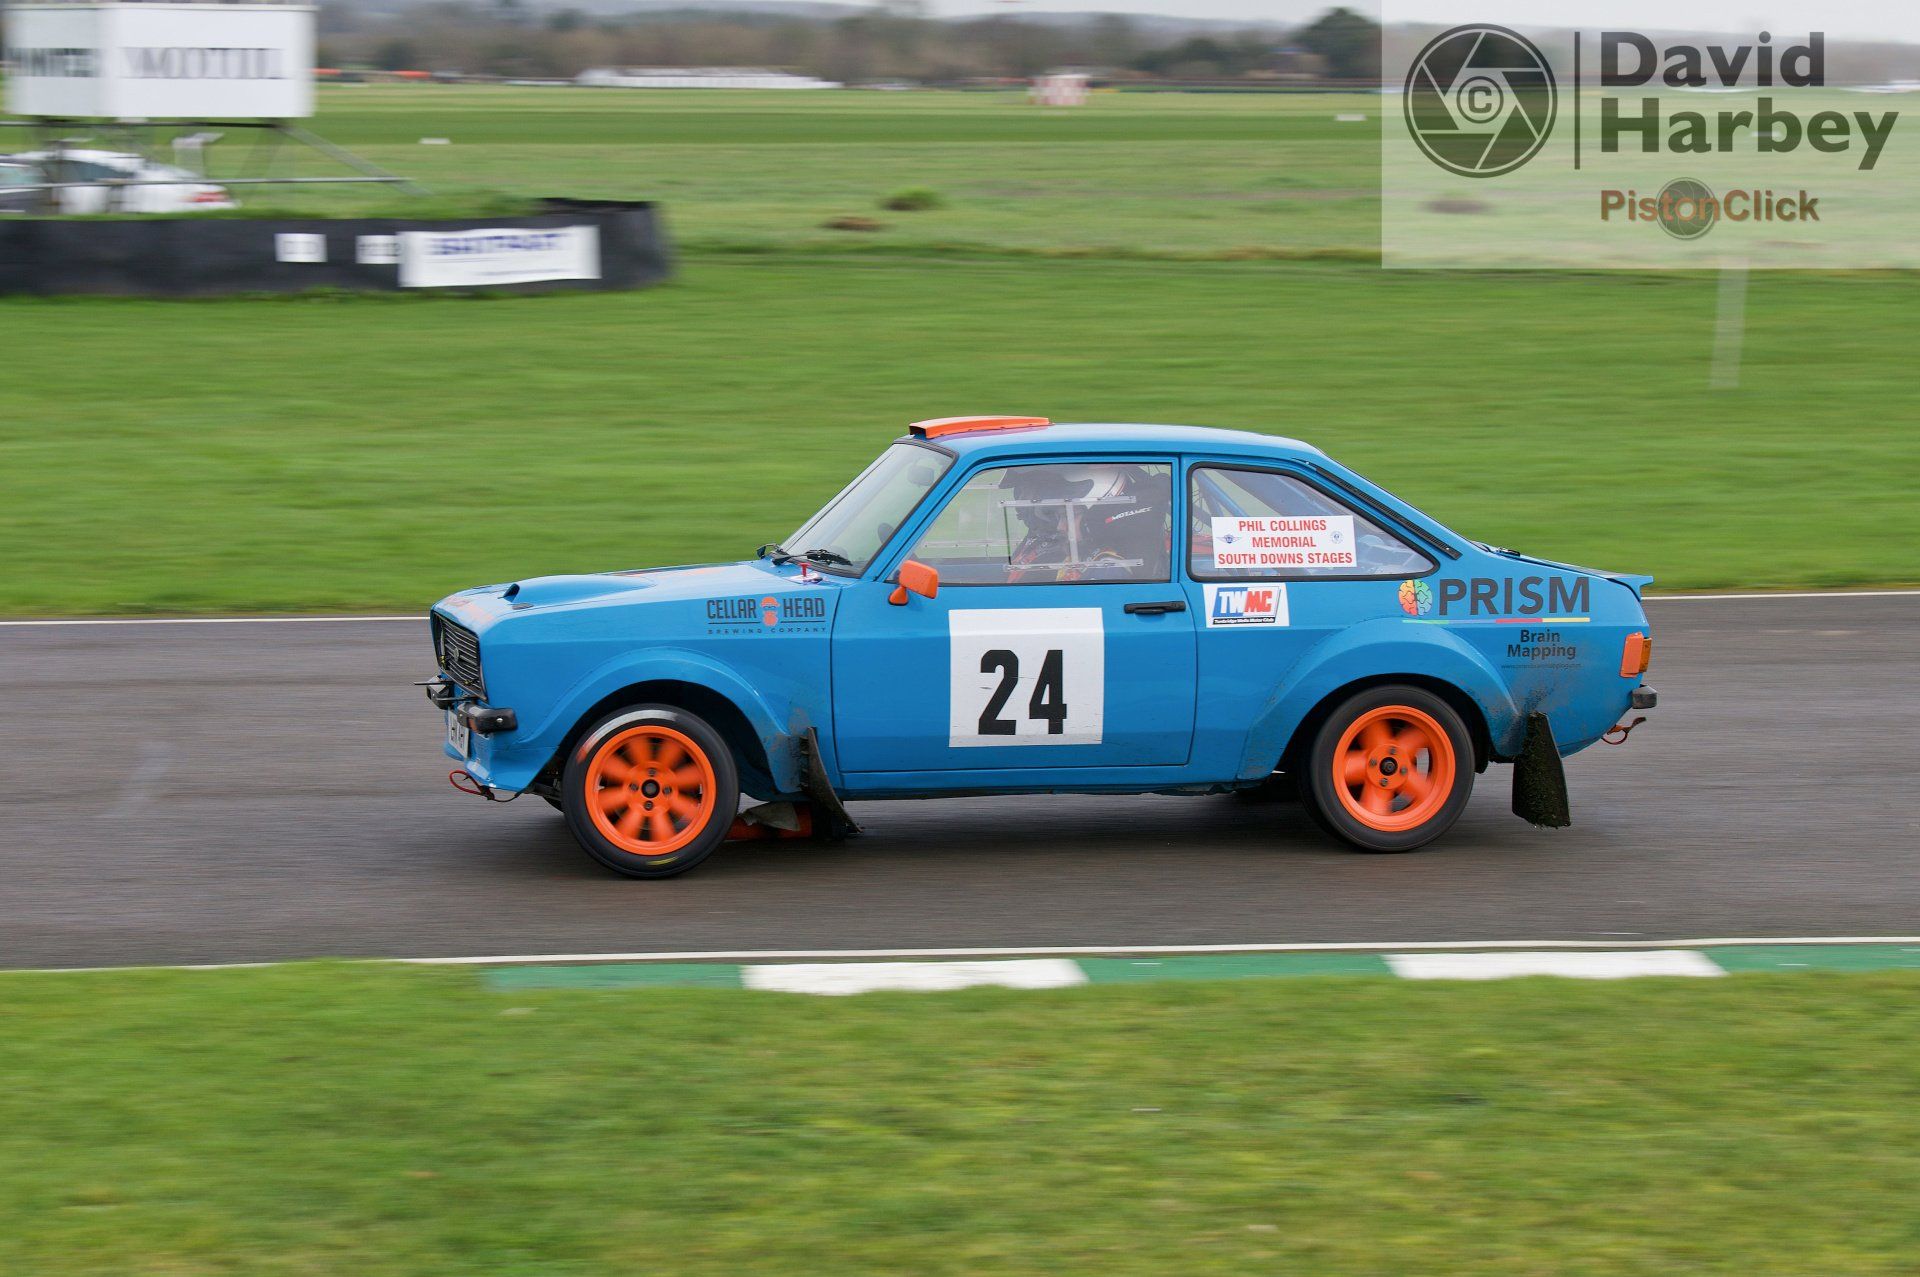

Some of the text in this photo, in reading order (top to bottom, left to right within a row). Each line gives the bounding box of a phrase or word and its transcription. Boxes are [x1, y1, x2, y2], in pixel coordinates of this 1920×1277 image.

[1238, 519, 1327, 532] PHIL COLLINGS
[1252, 536, 1317, 548] MEMORIAL
[1218, 552, 1353, 564] SOUTH DOWNS STAGES
[1218, 590, 1273, 613] TWMC
[1439, 576, 1590, 616] PRISM
[706, 597, 826, 619] CELLAR HEAD
[1520, 628, 1560, 642] Brain
[1507, 643, 1577, 661] Mapping
[978, 649, 1067, 735] 24
